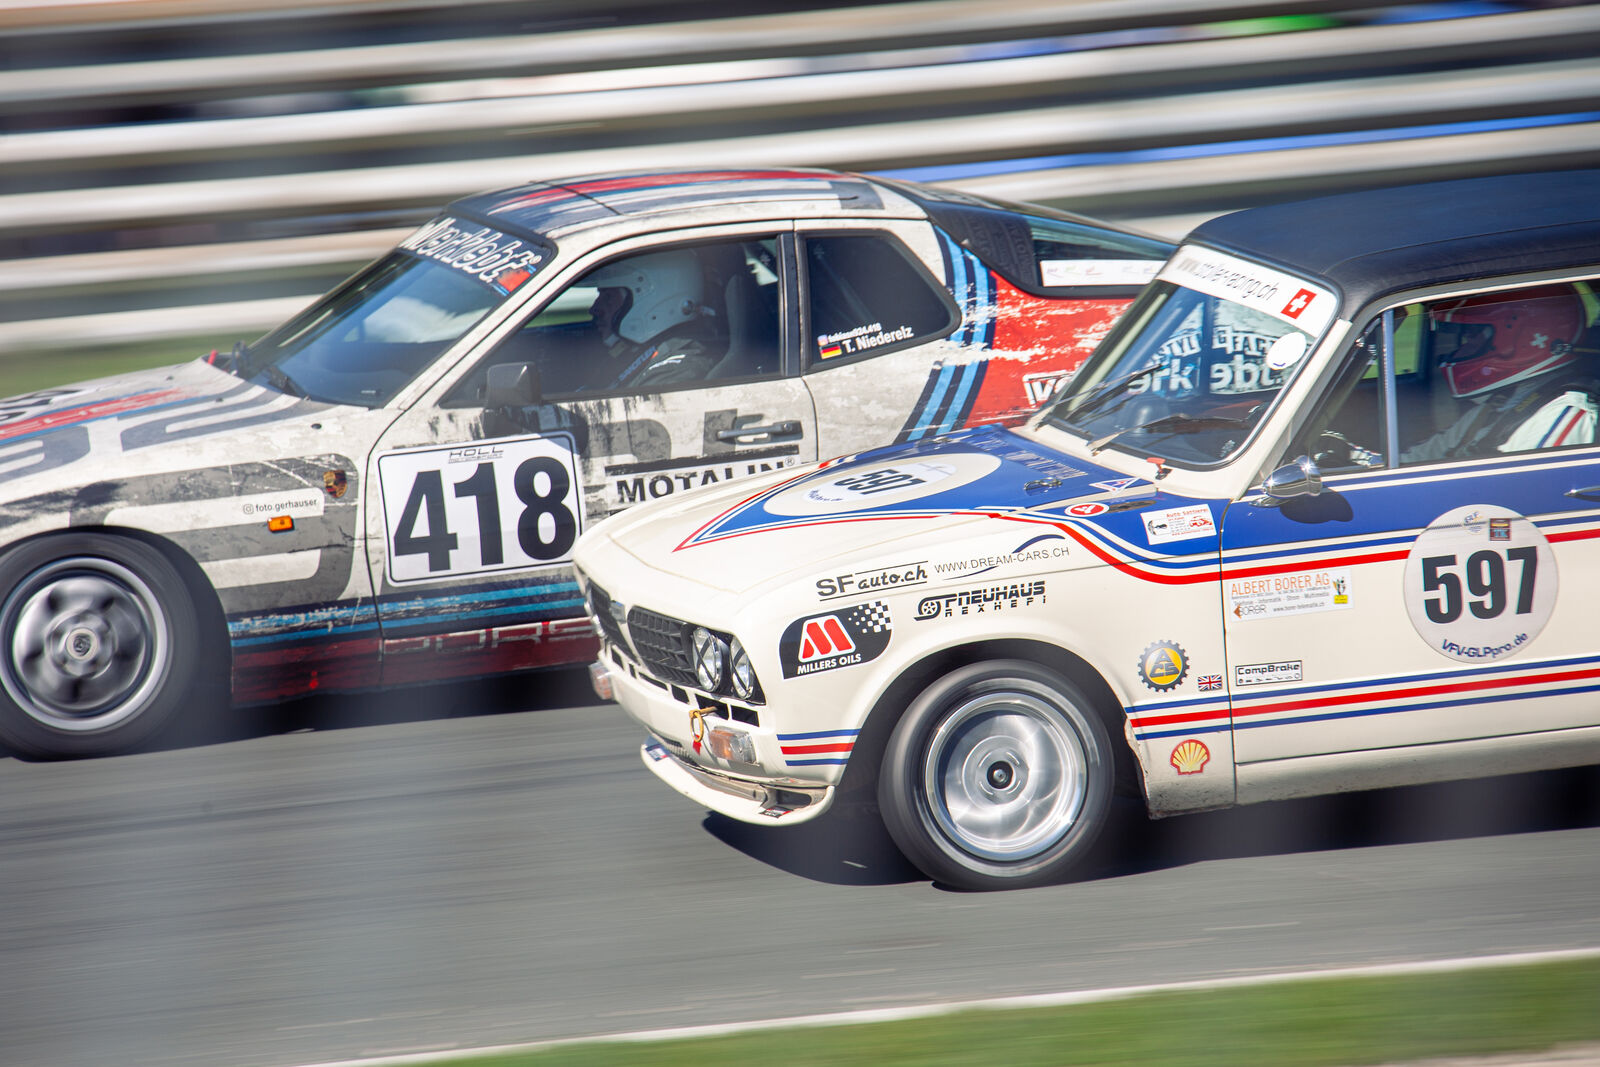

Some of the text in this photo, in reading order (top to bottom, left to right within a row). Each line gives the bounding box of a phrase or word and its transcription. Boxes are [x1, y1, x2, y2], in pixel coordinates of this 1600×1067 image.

[841, 325, 915, 353] T. Niederelz
[449, 447, 504, 458] HOLL
[834, 468, 927, 495] 597
[394, 457, 577, 572] 418
[934, 547, 1070, 574] WWW.DREAM-CARS.CH
[945, 581, 1046, 608] PNEUHAUS
[1231, 579, 1272, 596] ALBERT
[1275, 575, 1312, 591] BORER
[1315, 573, 1330, 587] AG
[1422, 546, 1538, 624] 597
[797, 653, 862, 675] MILLERS OILS
[1237, 664, 1300, 676] CompBrake
